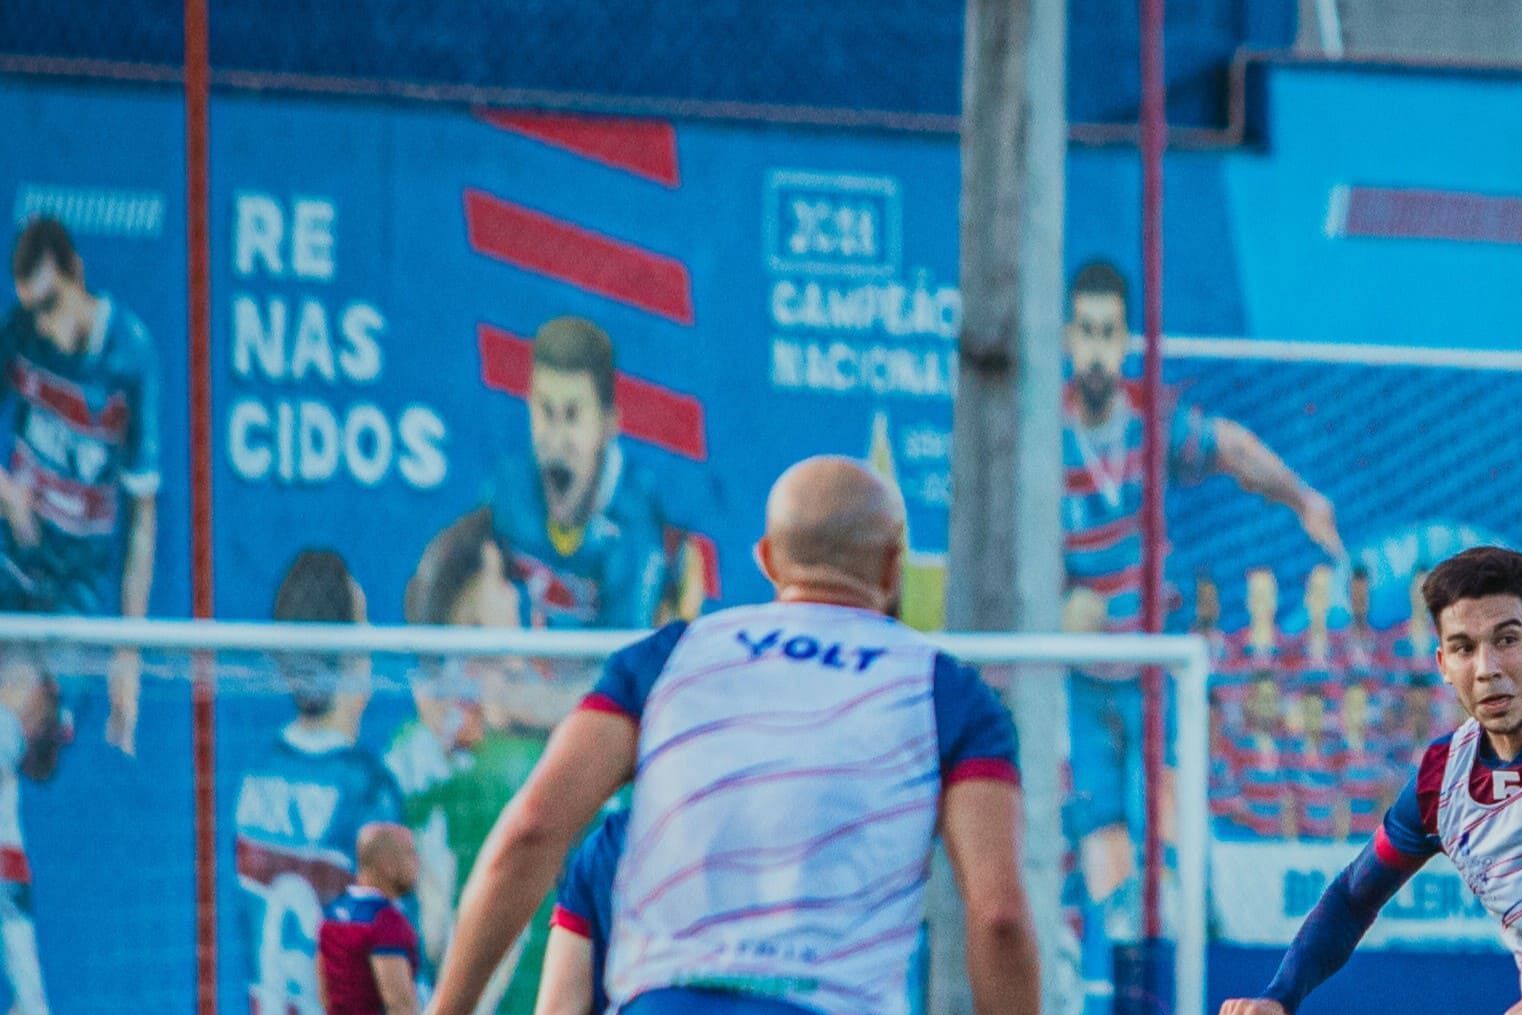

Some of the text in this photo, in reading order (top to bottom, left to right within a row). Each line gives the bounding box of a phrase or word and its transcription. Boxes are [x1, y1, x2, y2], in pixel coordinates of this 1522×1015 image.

[234, 196, 334, 278] RE
[232, 298, 385, 382] NAS
[228, 402, 449, 488] CIDOS
[735, 628, 889, 673] VOLT
